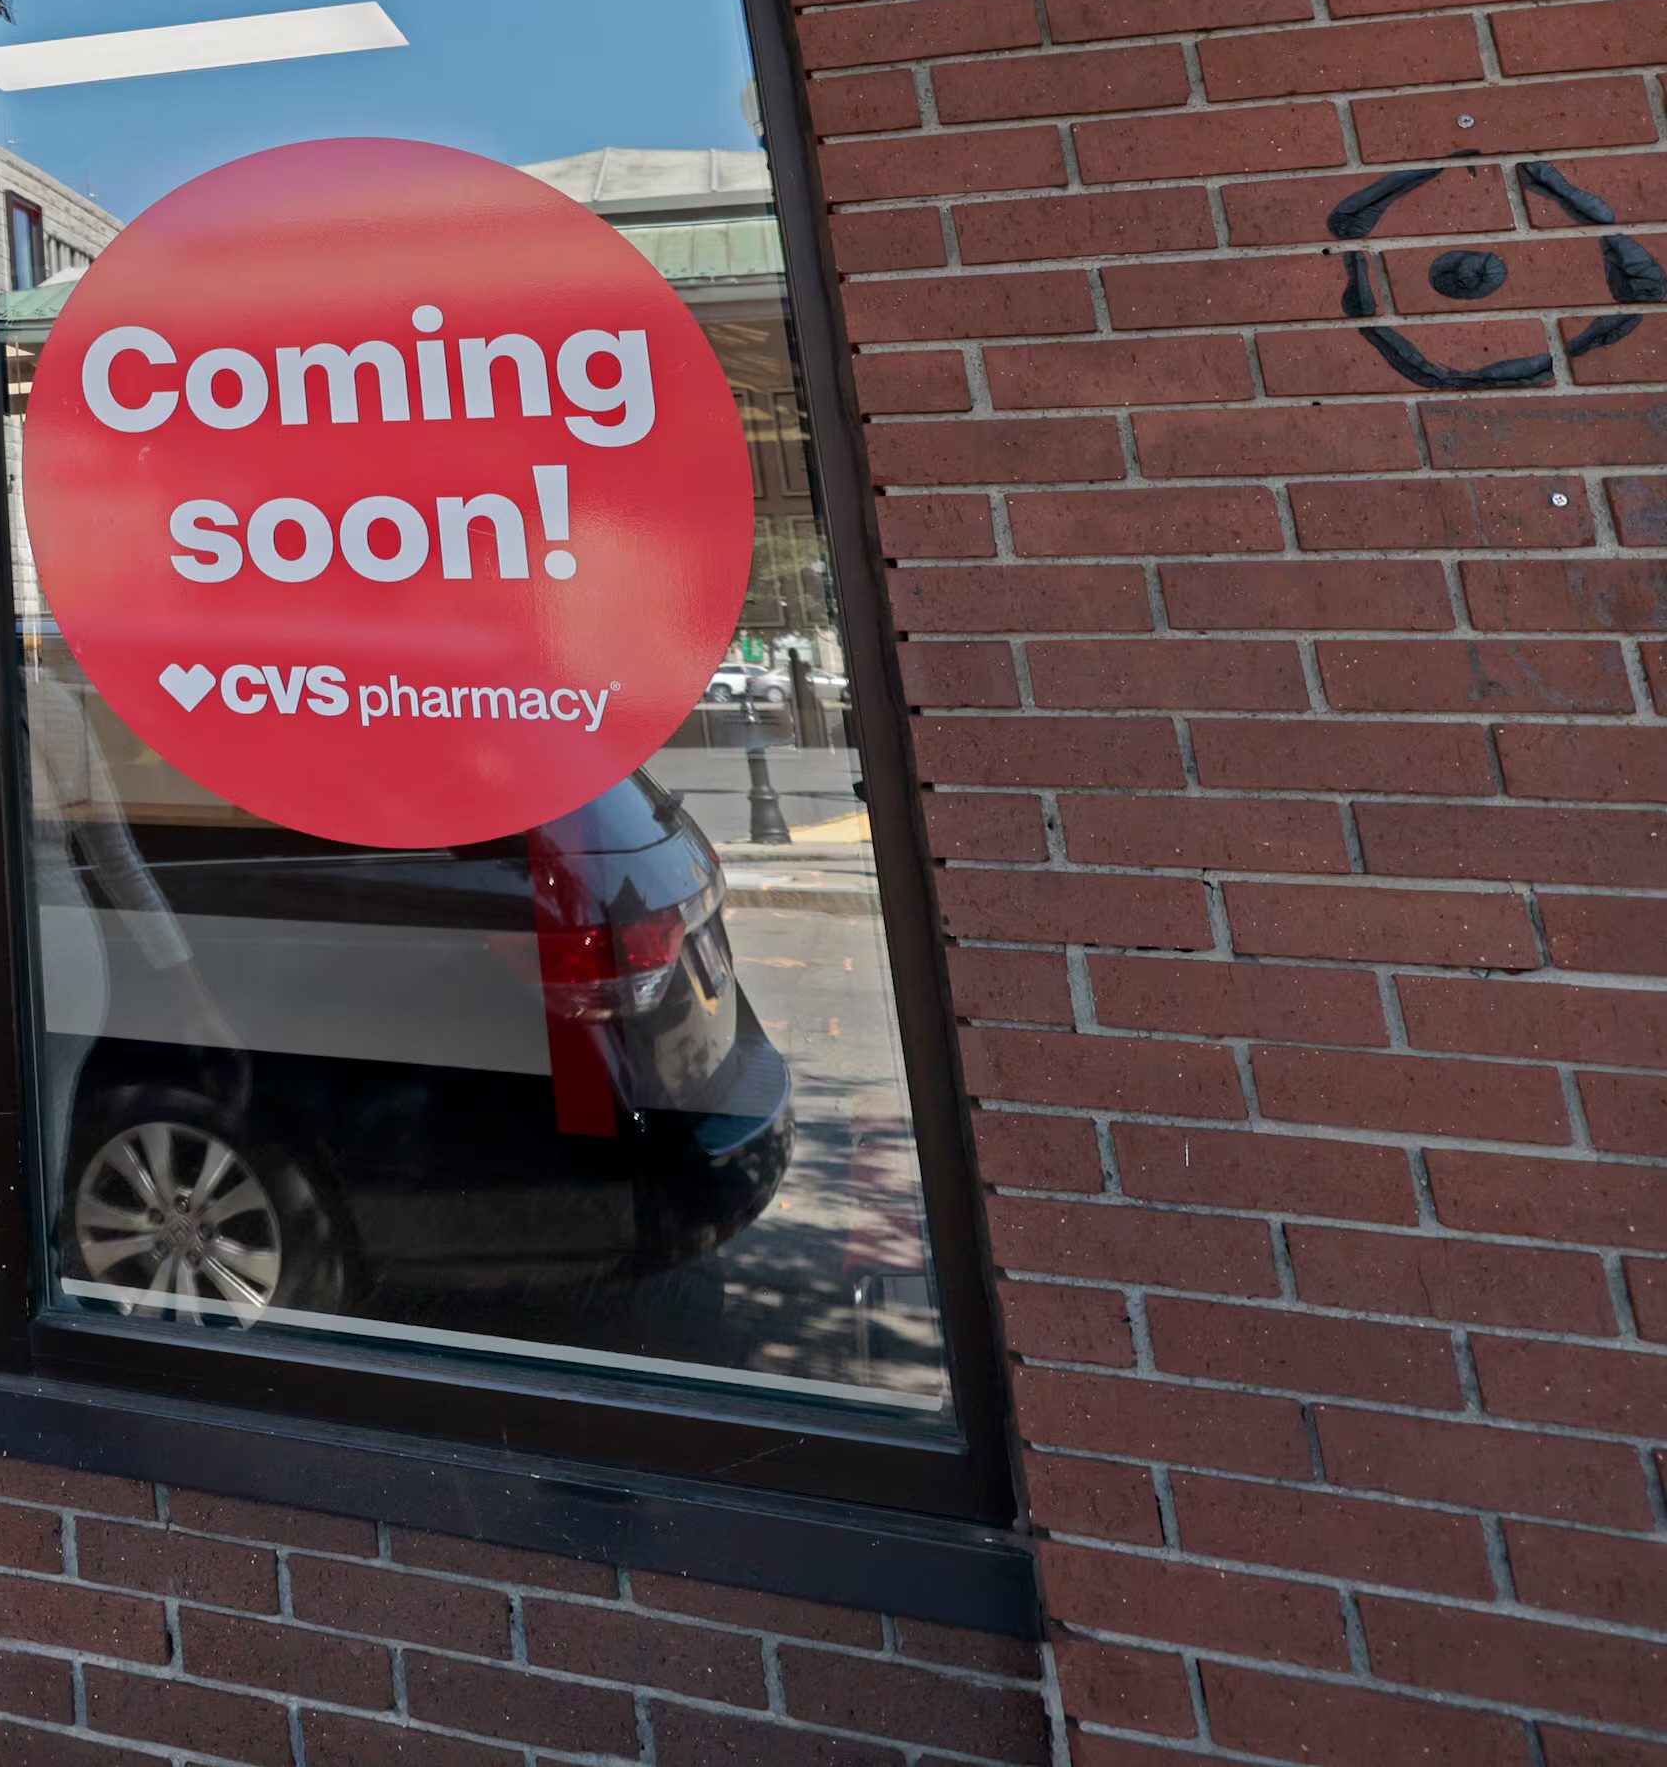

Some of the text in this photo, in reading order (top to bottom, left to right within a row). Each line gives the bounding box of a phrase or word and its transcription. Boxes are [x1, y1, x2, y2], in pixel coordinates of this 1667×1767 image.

[81, 304, 656, 448] Coming
[169, 464, 578, 584] soon!
[220, 663, 611, 734] CVS pharmacy
